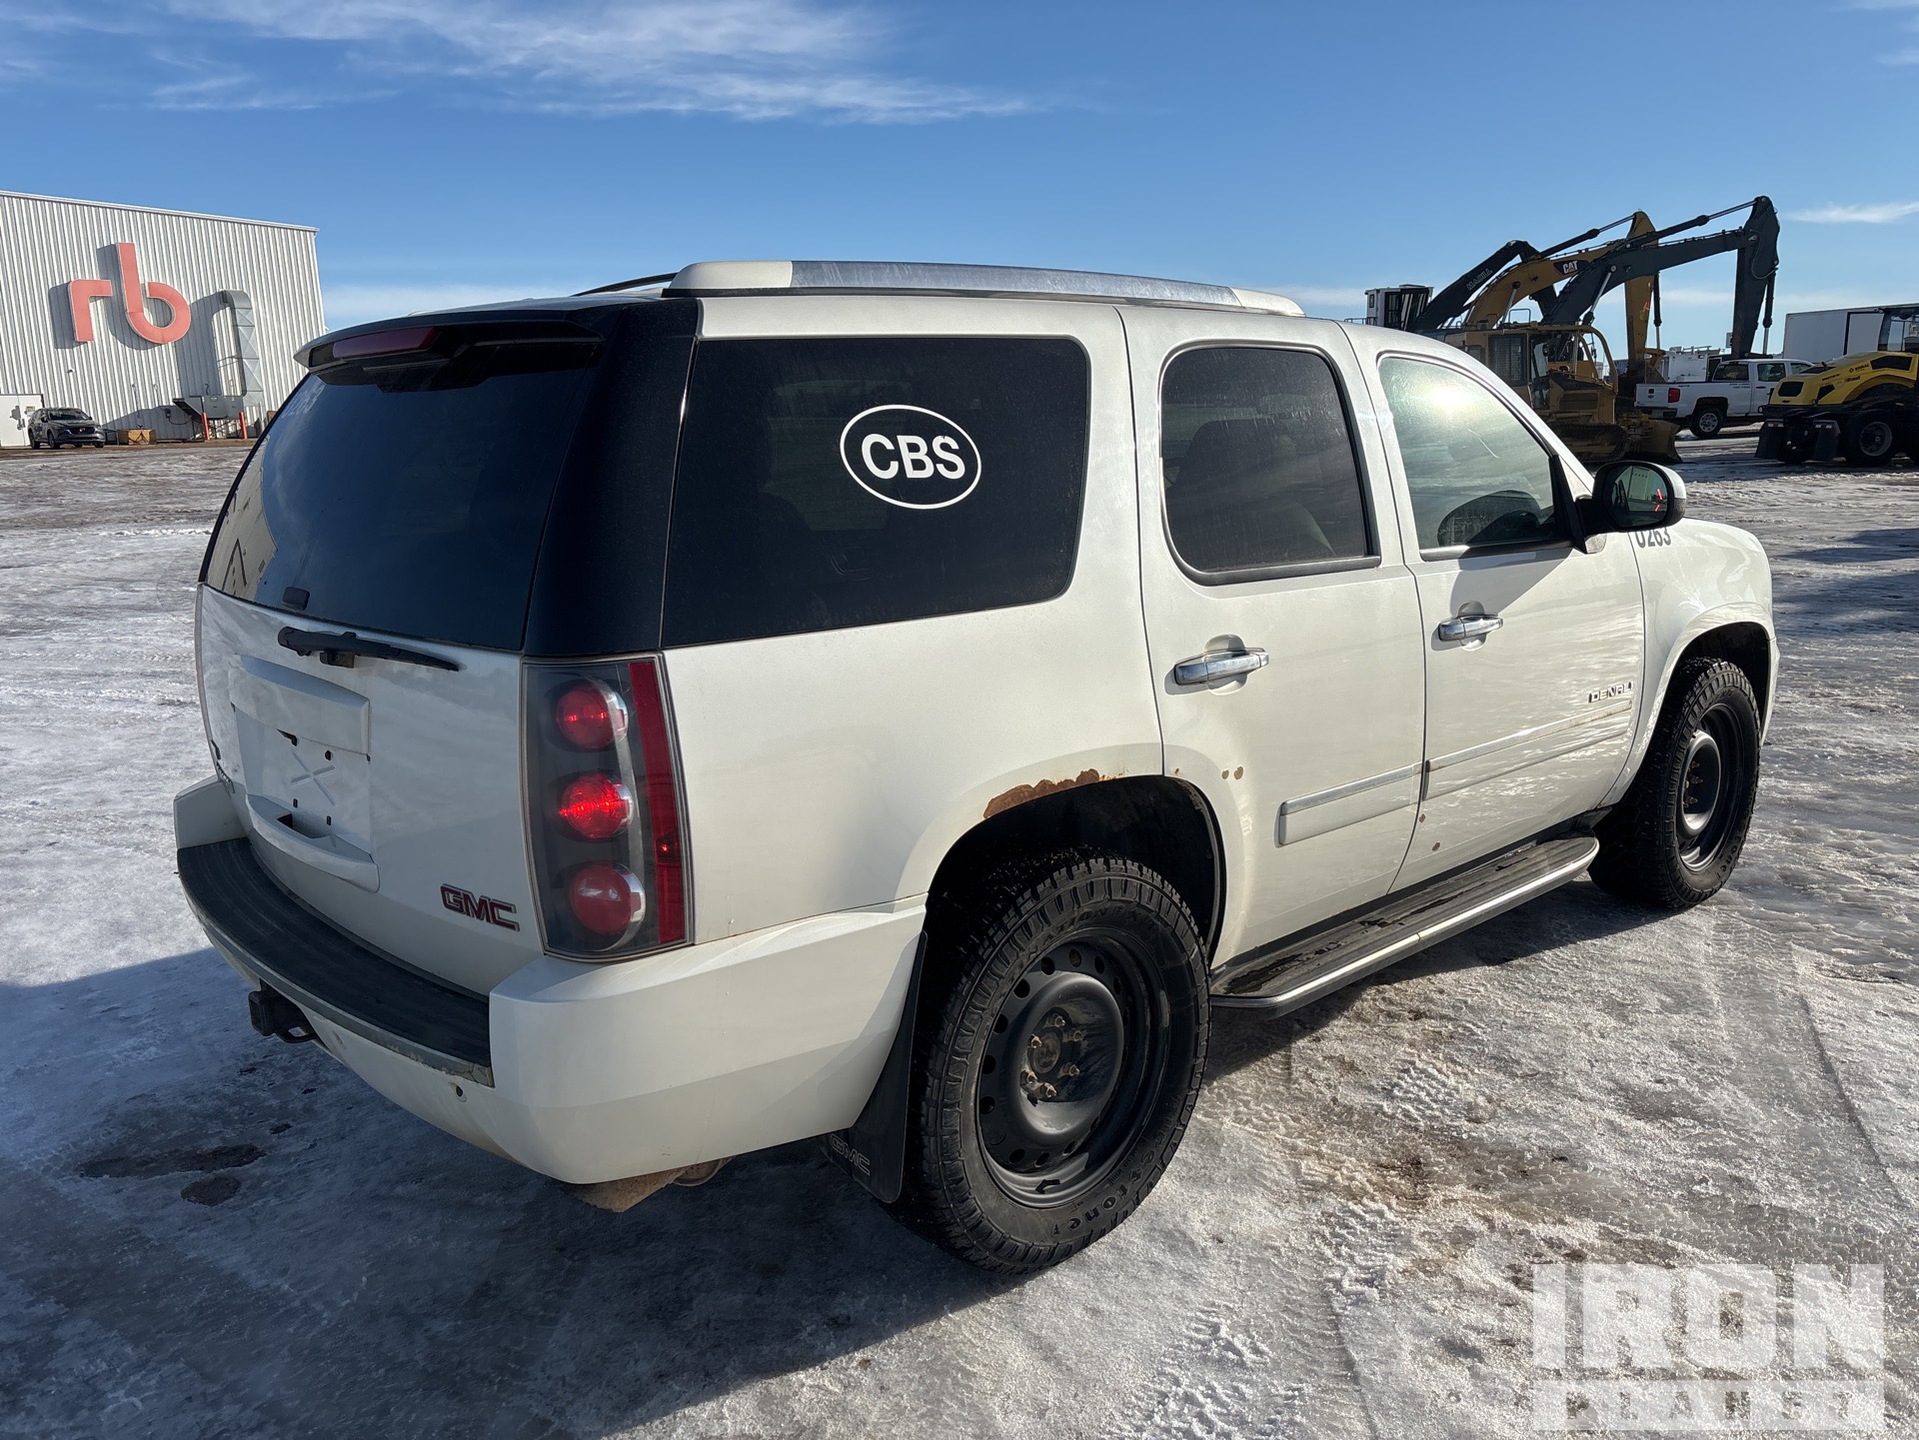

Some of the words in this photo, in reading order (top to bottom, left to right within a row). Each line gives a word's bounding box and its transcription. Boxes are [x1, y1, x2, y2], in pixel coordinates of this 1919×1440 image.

[1562, 260, 1579, 275] CAT
[69, 241, 192, 345] rb
[861, 433, 966, 480] CBS
[1588, 681, 1632, 704] DENALI
[440, 883, 520, 932] GMC
[831, 1133, 871, 1176] GMC
